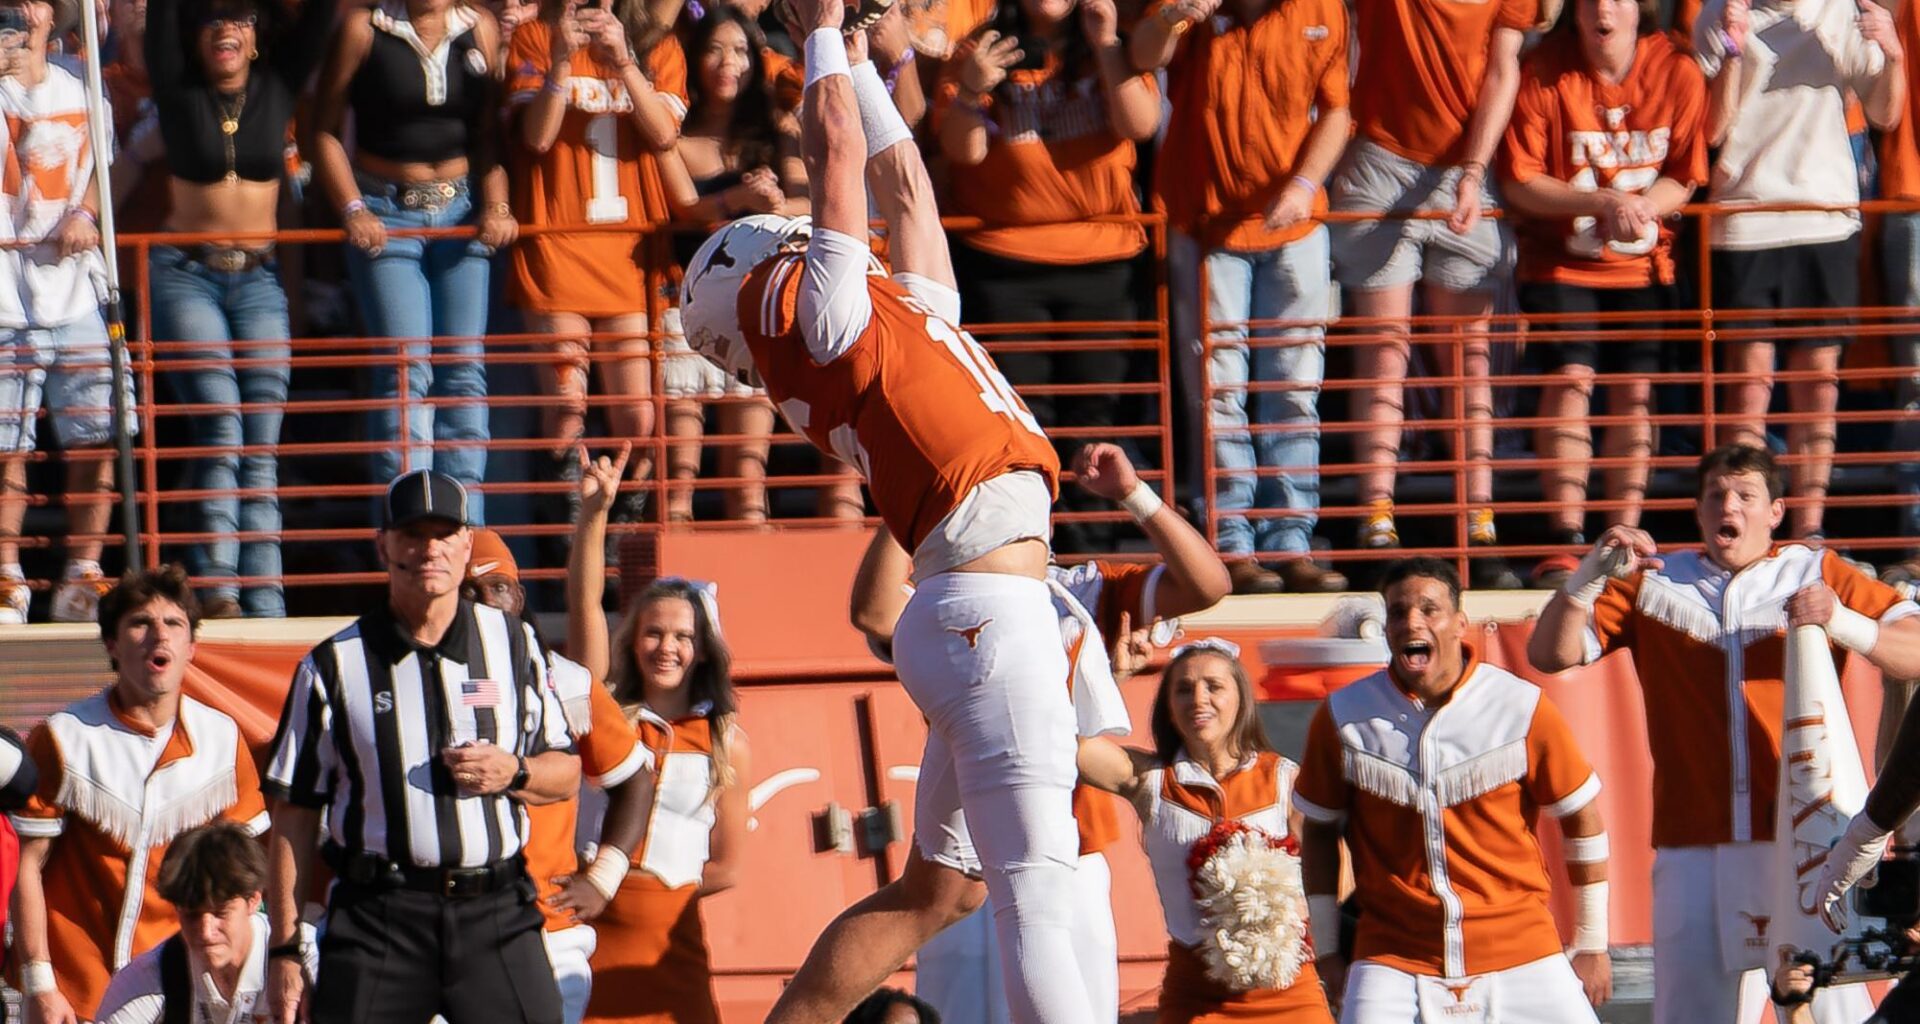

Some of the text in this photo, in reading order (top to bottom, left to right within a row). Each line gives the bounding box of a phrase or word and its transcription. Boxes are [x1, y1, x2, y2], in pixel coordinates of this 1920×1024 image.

[565, 76, 634, 114] TEXA
[1569, 126, 1671, 168] TEXAS
[585, 113, 629, 225] 1
